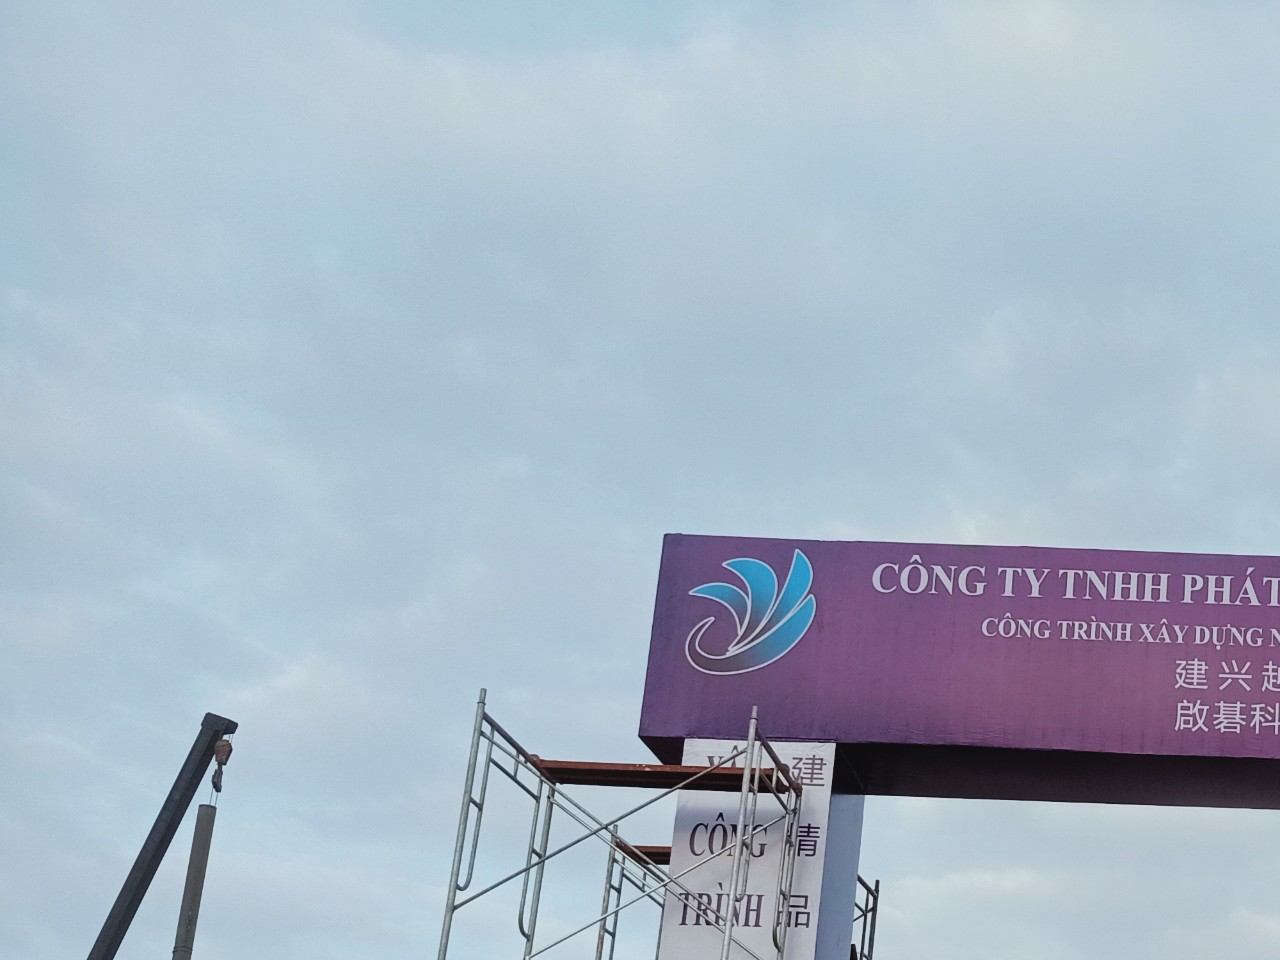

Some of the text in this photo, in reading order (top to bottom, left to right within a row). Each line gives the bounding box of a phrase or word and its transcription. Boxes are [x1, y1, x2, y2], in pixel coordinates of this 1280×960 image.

[872, 555, 987, 597] CÔNG
[997, 567, 1051, 598] TY
[1058, 569, 1171, 603] TNHH
[981, 612, 1051, 639] CÔNG
[1057, 616, 1133, 642] TRÌNH
[1139, 618, 1189, 644] XÂY
[1193, 624, 1264, 651] DỰNG
